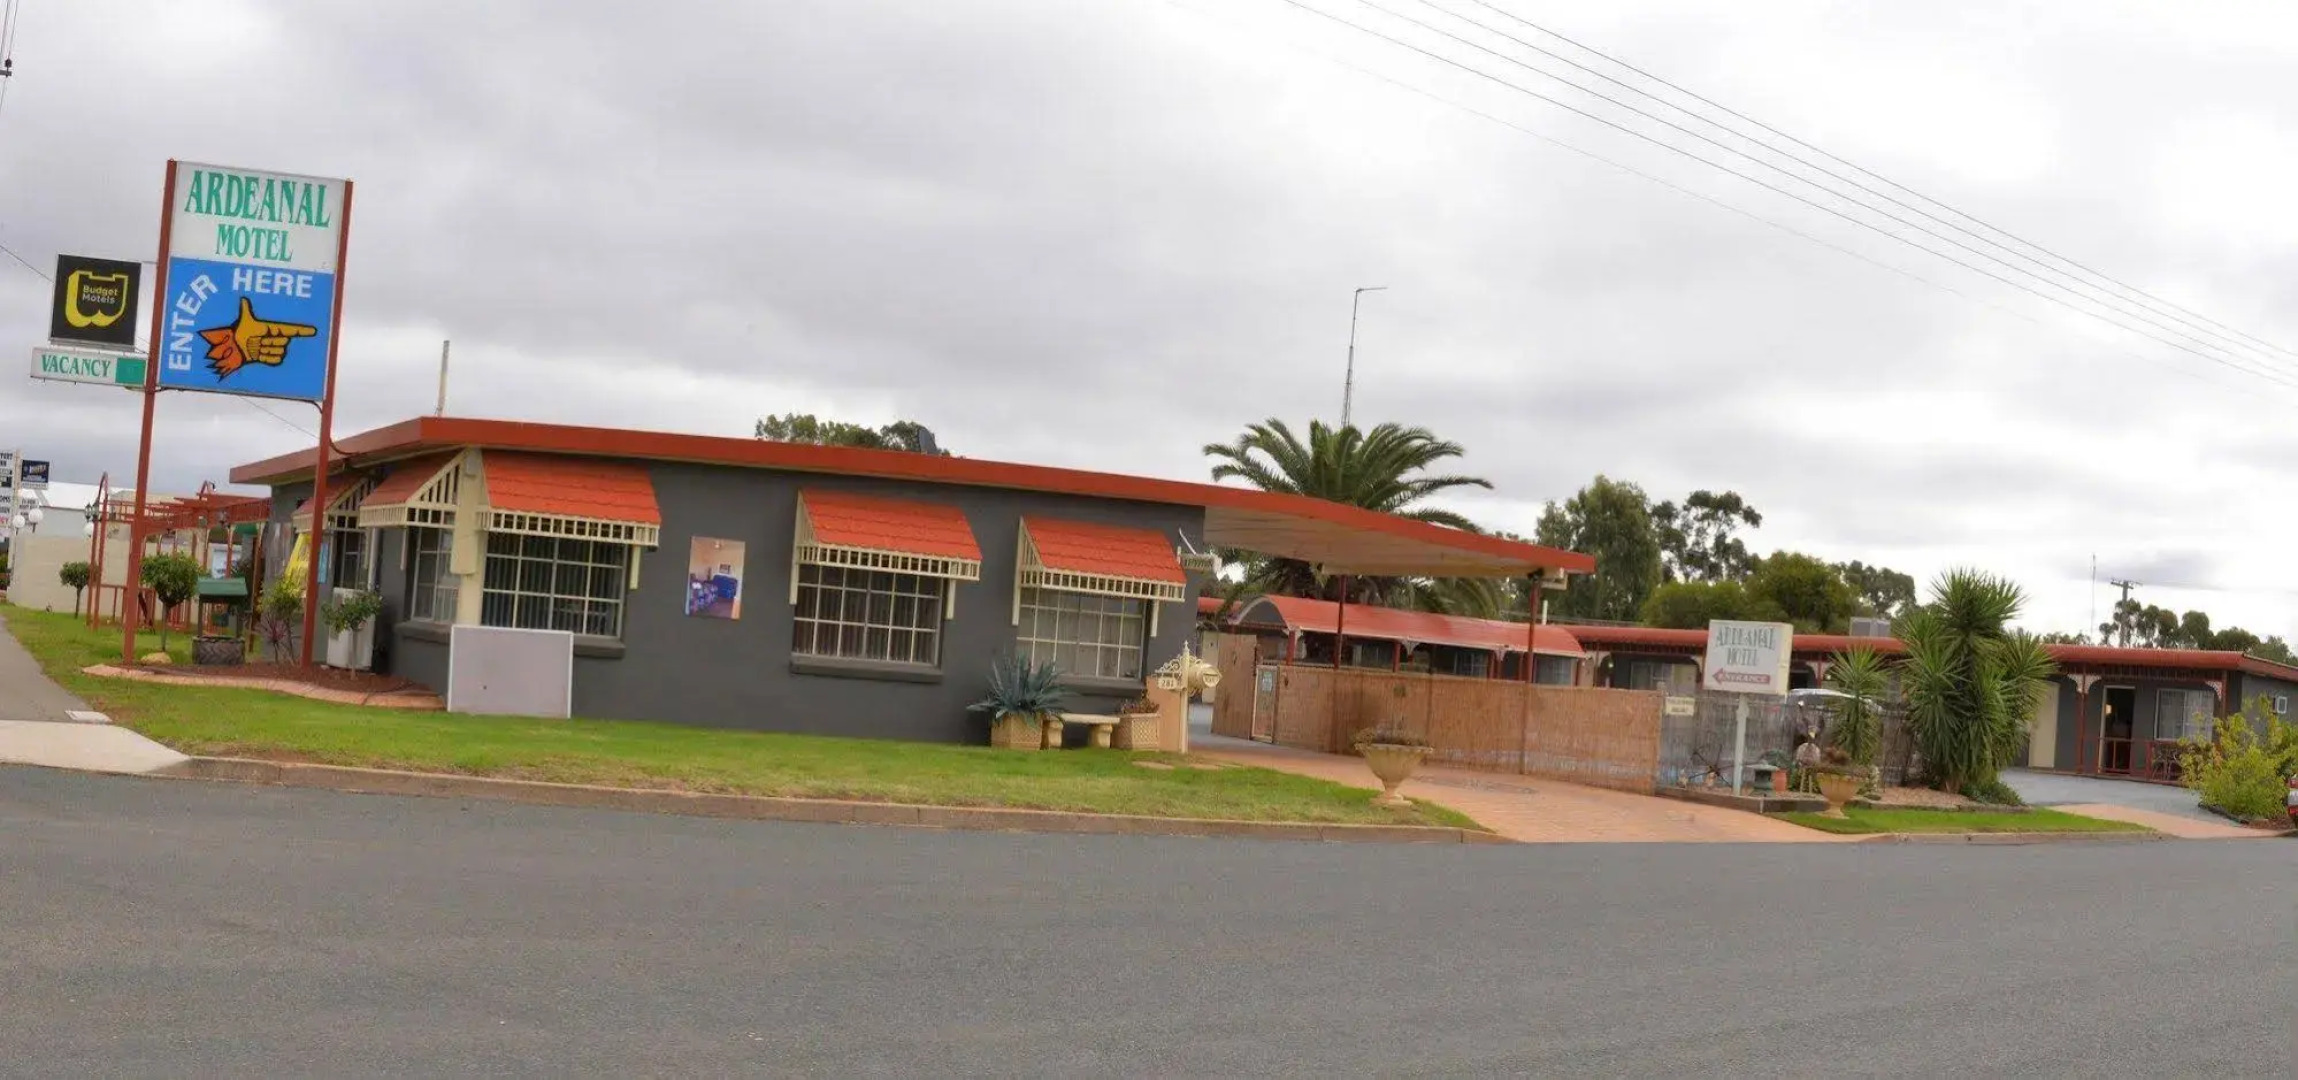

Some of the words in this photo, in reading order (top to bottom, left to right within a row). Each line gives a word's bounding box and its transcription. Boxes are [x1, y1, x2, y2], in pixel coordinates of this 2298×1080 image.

[184, 170, 331, 228] ARDEANAL
[215, 223, 292, 262] MOTEL
[82, 293, 116, 304] Motels
[83, 285, 118, 296] Budget
[168, 274, 219, 371] ENTER
[232, 268, 313, 298] HERE
[41, 354, 109, 377] VACANCY
